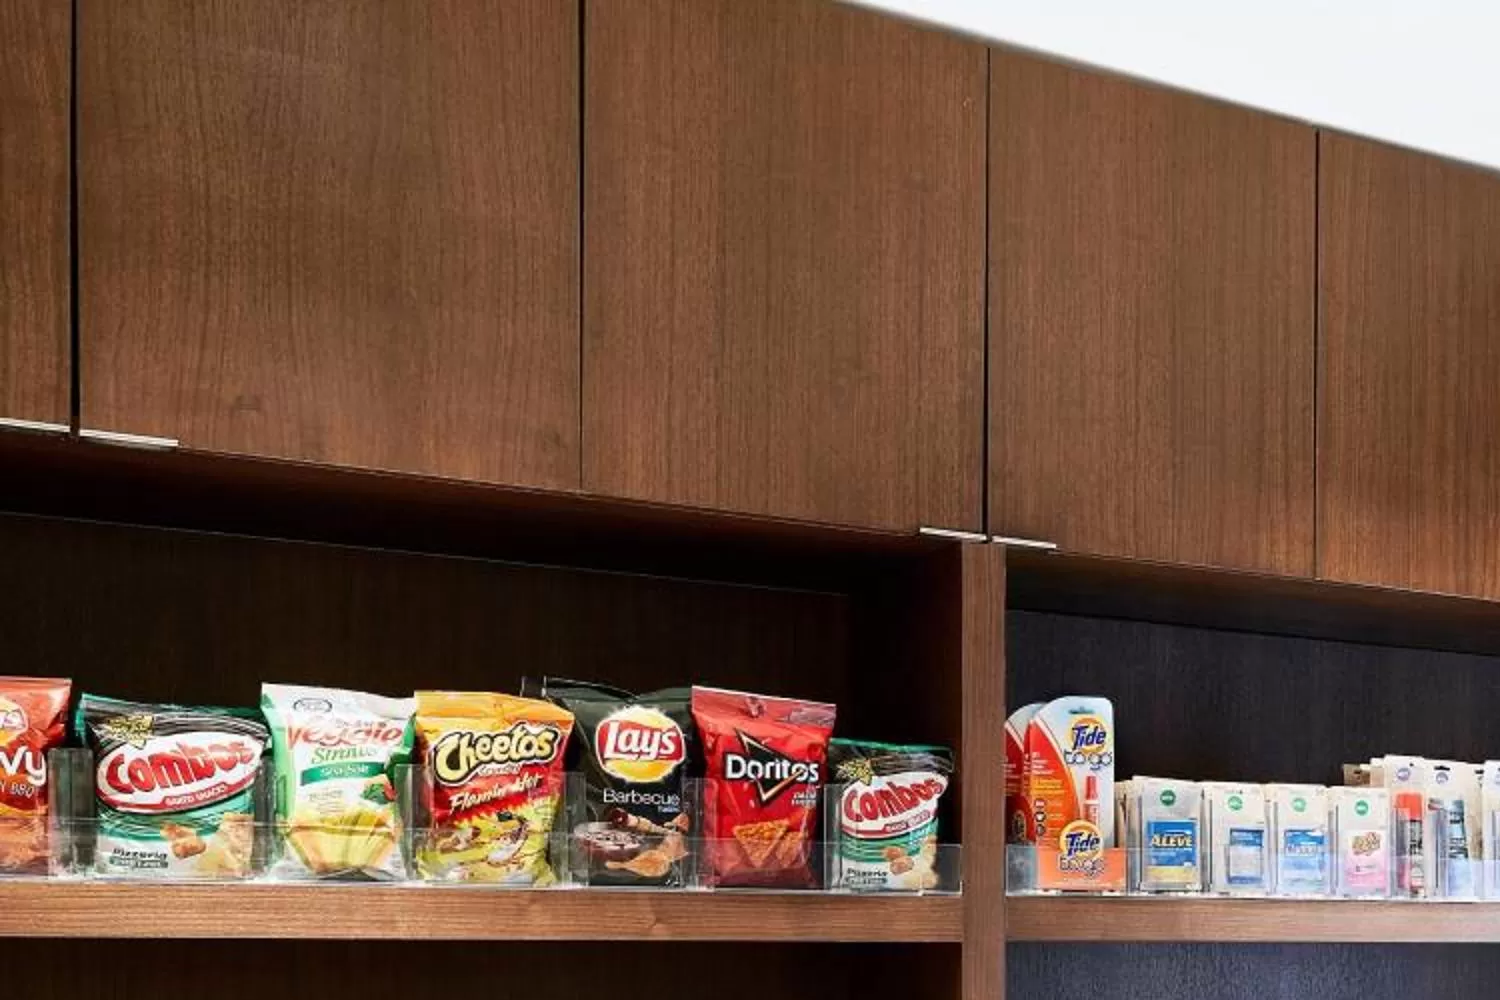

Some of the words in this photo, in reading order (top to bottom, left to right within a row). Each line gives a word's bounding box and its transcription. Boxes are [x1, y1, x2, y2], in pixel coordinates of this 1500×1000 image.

[1072, 725, 1107, 750] Tide
[0, 745, 47, 787] vy
[105, 741, 254, 794] Combos
[435, 722, 558, 784] Cheetos
[725, 753, 819, 782] Doritos
[603, 787, 680, 805] Barbecue
[843, 777, 945, 822] Combos
[1066, 832, 1100, 857] Tide
[1152, 833, 1193, 848] ALEVE
